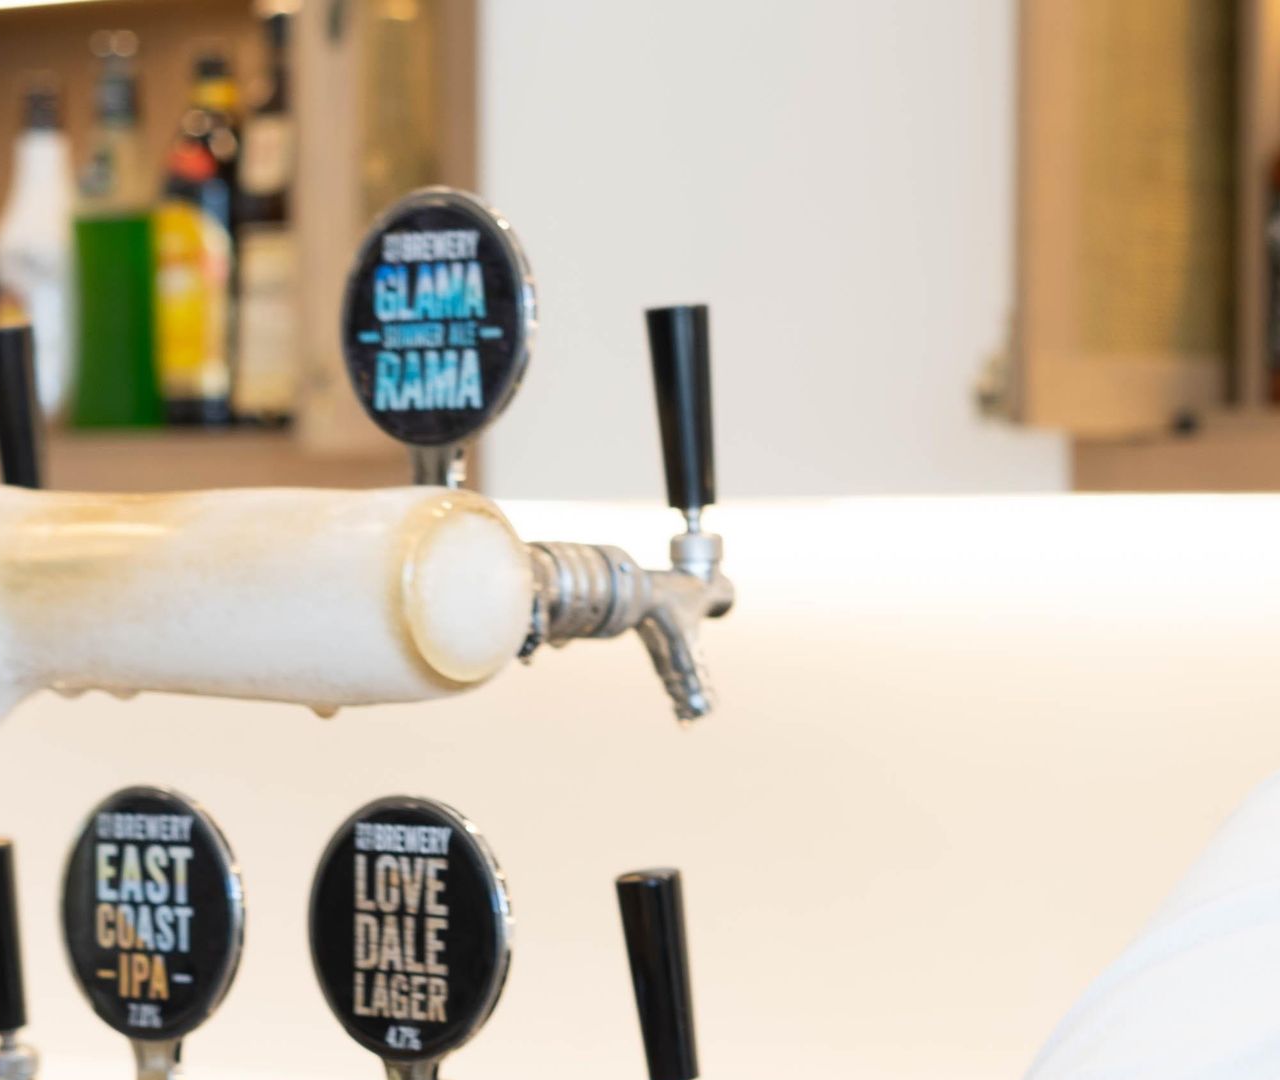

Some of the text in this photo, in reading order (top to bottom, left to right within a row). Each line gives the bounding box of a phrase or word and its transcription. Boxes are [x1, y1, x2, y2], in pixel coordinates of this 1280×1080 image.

[373, 261, 487, 321] GLAMA
[373, 348, 483, 411] RAMA
[95, 844, 194, 904] EAST
[353, 853, 449, 916] LOVE
[95, 902, 195, 953] COAST
[353, 912, 449, 976] DALE
[117, 952, 170, 1000] IPA
[353, 970, 448, 1023] LAGER
